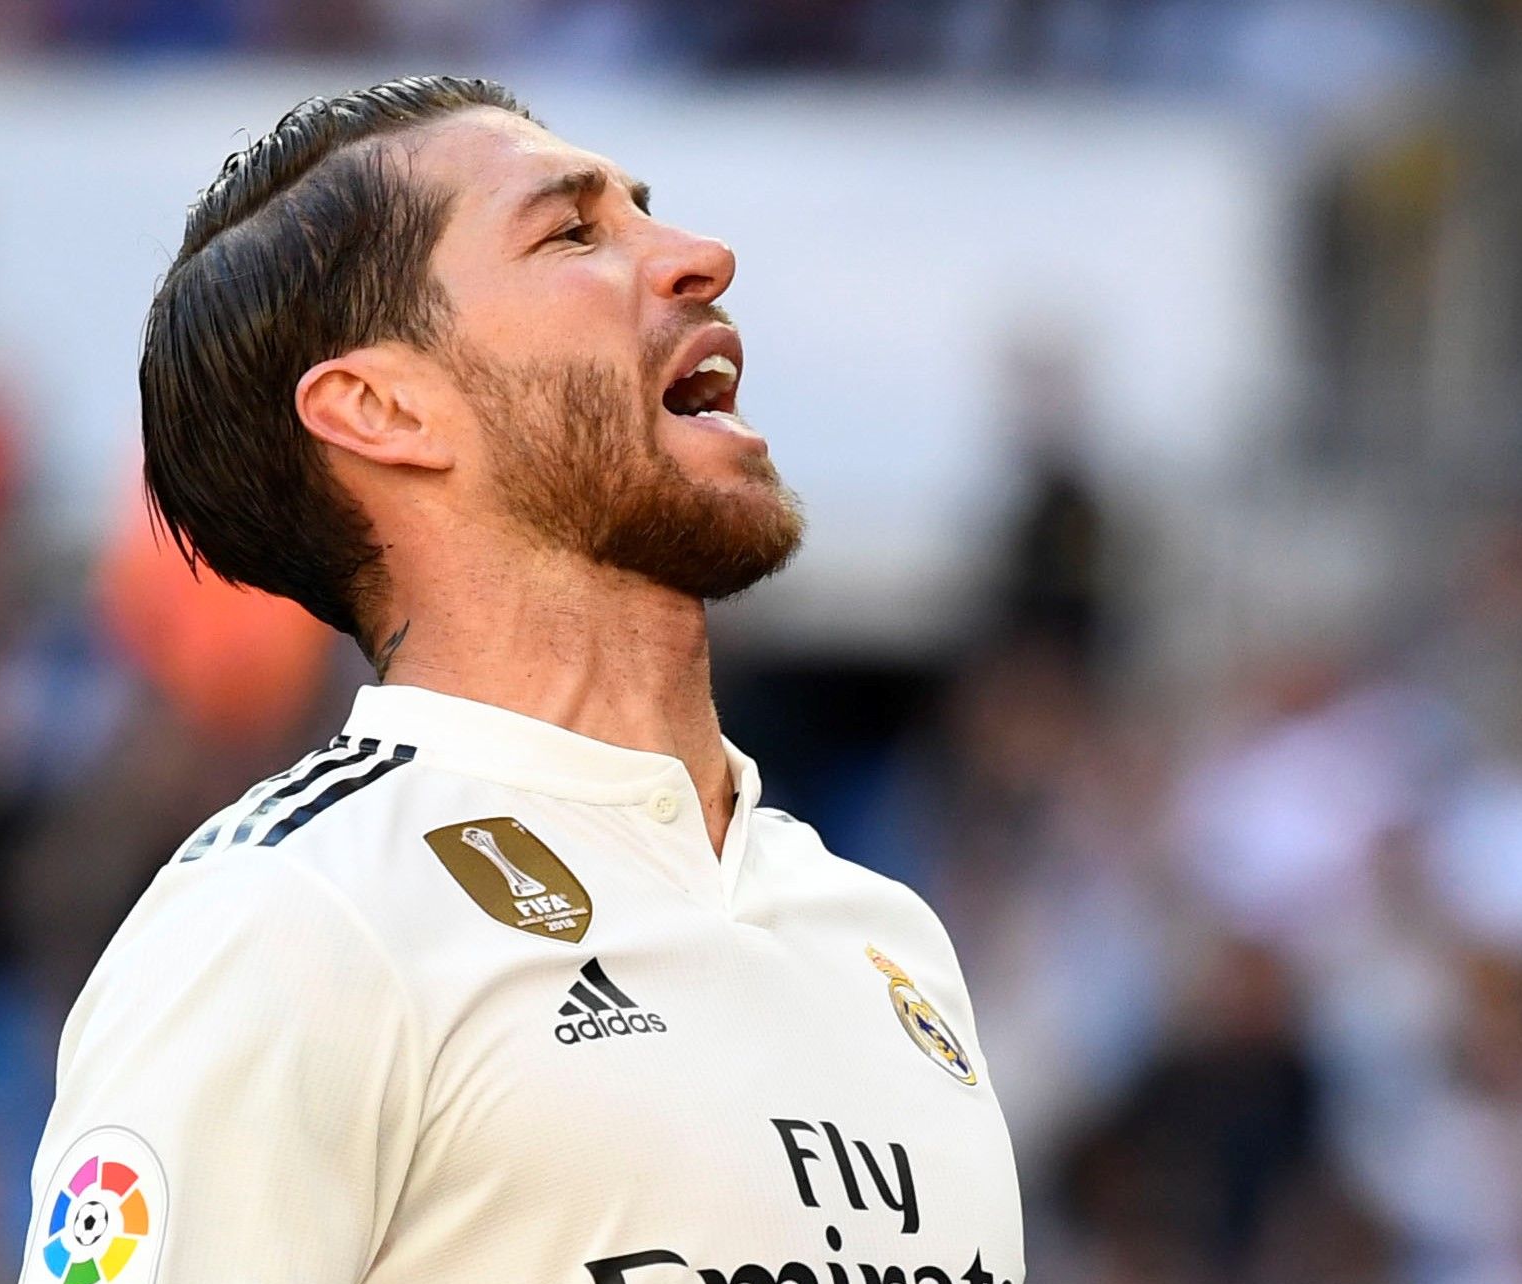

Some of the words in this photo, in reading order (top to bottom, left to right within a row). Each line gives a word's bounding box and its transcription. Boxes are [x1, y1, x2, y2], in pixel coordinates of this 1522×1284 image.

[513, 893, 572, 918] FIFA
[554, 1008, 668, 1045] adidas
[770, 1117, 920, 1235] Fly
